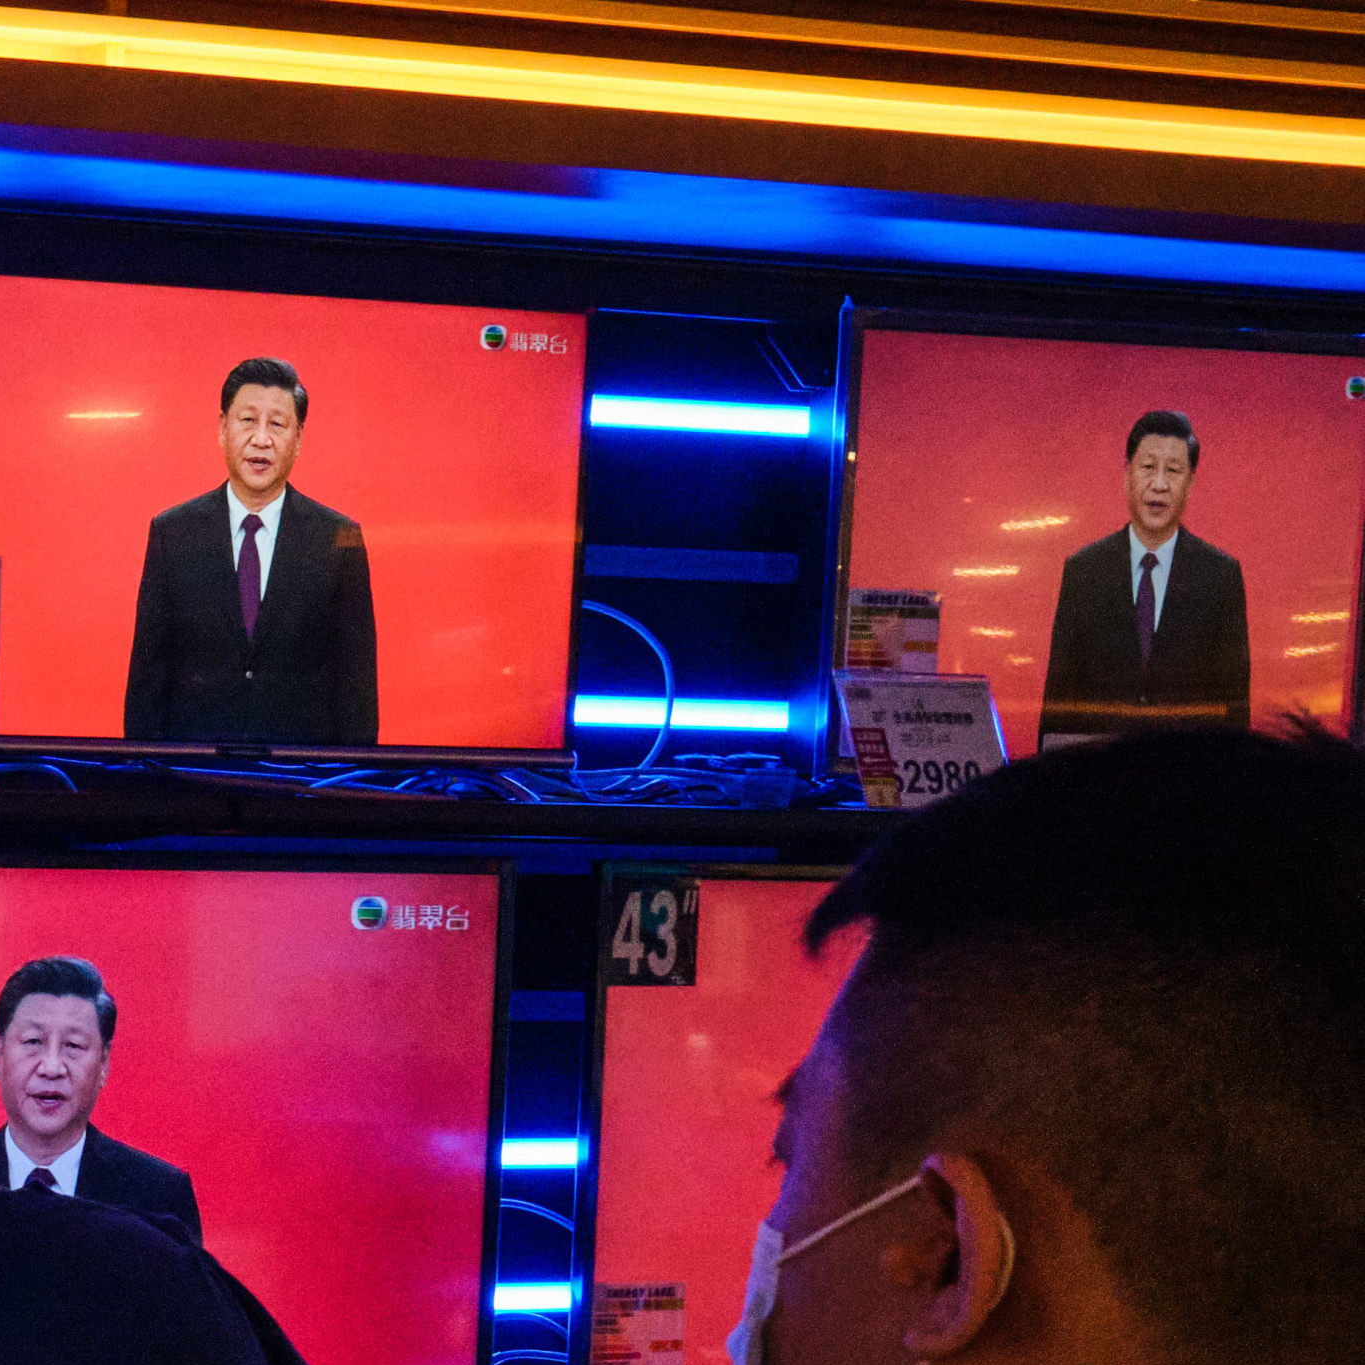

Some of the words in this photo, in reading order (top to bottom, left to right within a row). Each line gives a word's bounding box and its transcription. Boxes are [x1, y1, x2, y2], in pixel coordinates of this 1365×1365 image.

[510, 332, 567, 354] 翡翠台
[392, 905, 469, 931] 翡翠台
